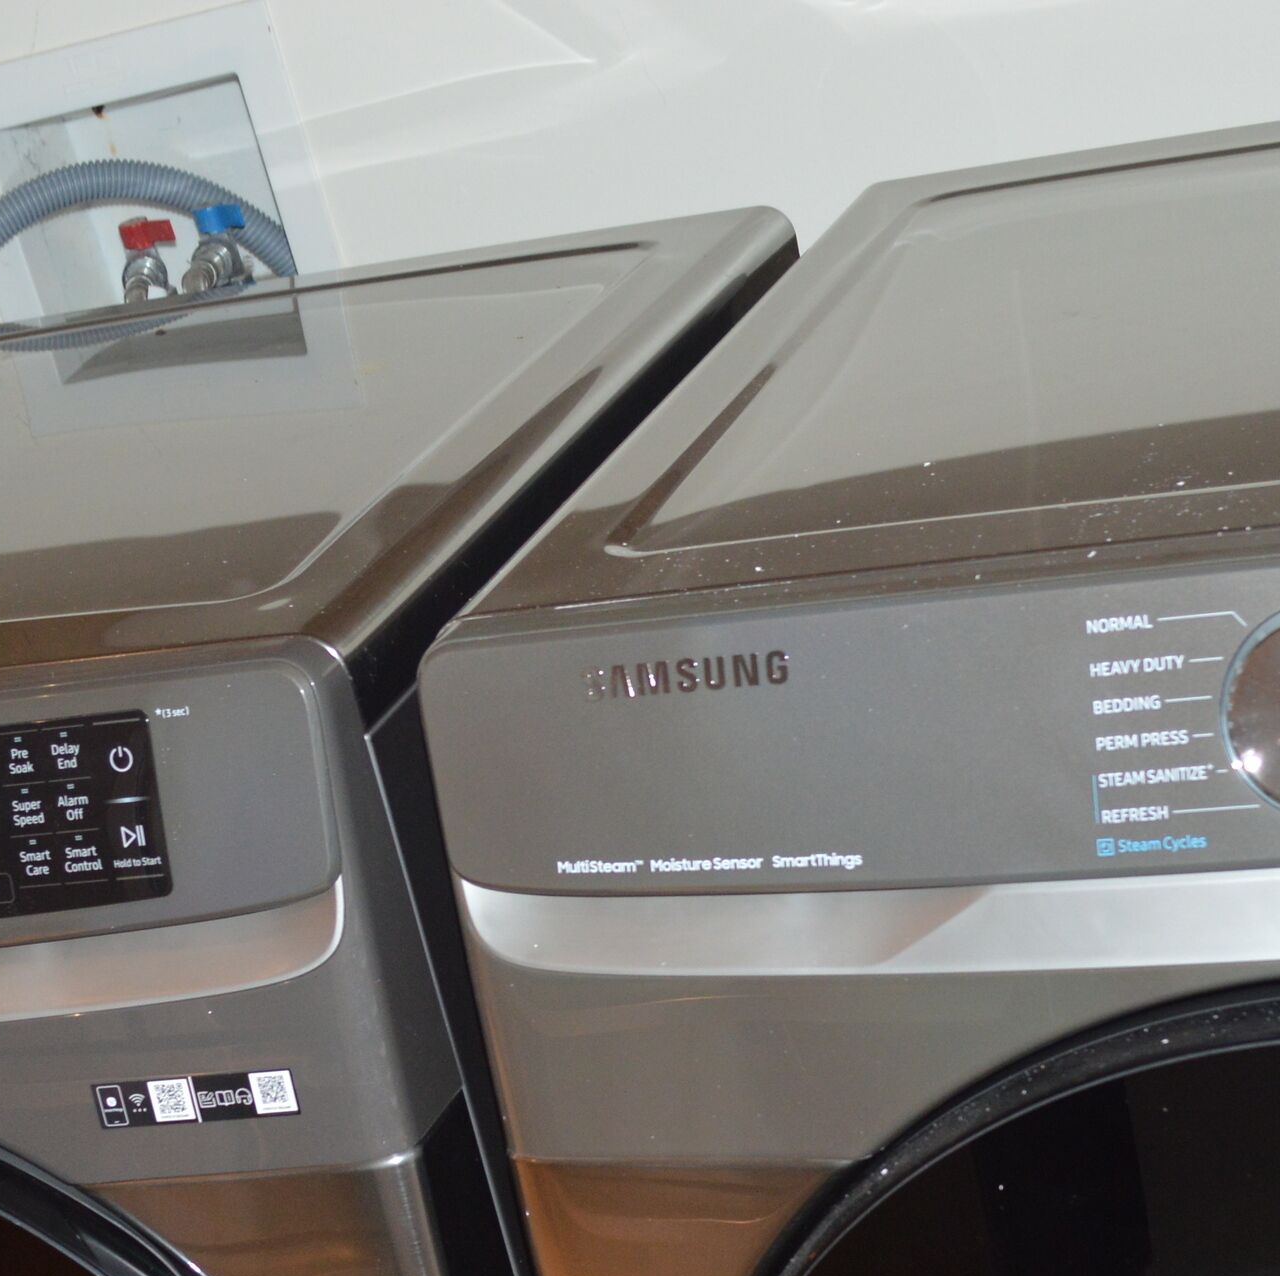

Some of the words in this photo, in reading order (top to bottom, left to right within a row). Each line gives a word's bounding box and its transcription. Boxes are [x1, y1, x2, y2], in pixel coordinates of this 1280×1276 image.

[1086, 614, 1154, 634] NORMAL
[1089, 659, 1140, 677] HEAVY
[1143, 655, 1185, 672] DUTY
[580, 650, 790, 702] SAMSUNG
[1092, 695, 1162, 715] BEDDING
[1095, 733, 1139, 751] PERM
[1140, 729, 1189, 748] PRESS
[10, 748, 29, 760] Pre
[50, 743, 80, 757] Delay
[8, 762, 34, 775] Soak
[57, 757, 78, 770] End
[1098, 770, 1145, 788] STEAM
[11, 799, 42, 814] Super
[57, 795, 89, 807] Alarm
[13, 813, 45, 828] Speed
[66, 808, 84, 821] Off
[1101, 805, 1169, 824] REFRESH
[1118, 837, 1162, 852] Steam
[1163, 834, 1207, 852] Cycles
[19, 850, 51, 863] Smart
[65, 846, 98, 859] Smart
[64, 859, 103, 873] Control
[113, 859, 132, 869] Hold
[132, 858, 142, 867] to
[142, 856, 163, 866] Start
[650, 857, 712, 873] Moisture
[713, 856, 763, 871] Sensor
[772, 852, 863, 870] SmartThings
[26, 865, 50, 876] Care
